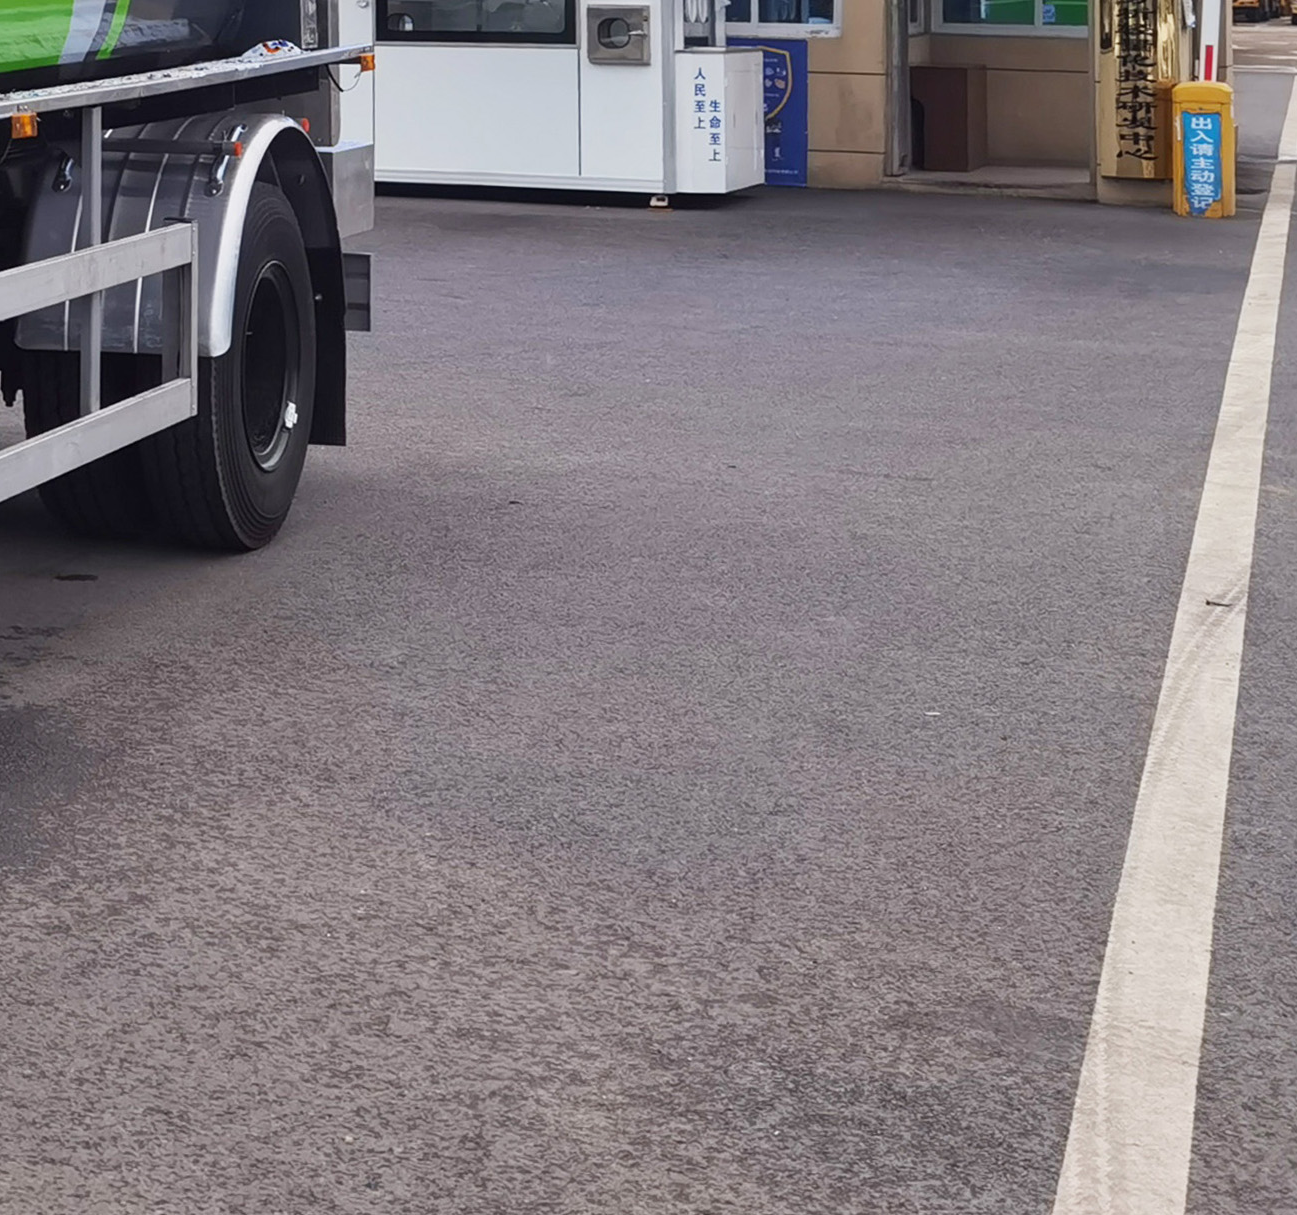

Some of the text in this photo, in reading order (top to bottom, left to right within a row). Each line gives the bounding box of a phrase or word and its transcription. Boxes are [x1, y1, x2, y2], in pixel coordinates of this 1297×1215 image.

[694, 67, 706, 130] 人民至上
[709, 99, 721, 161] 生命至上
[1190, 117, 1215, 209] 出入请主动登记
